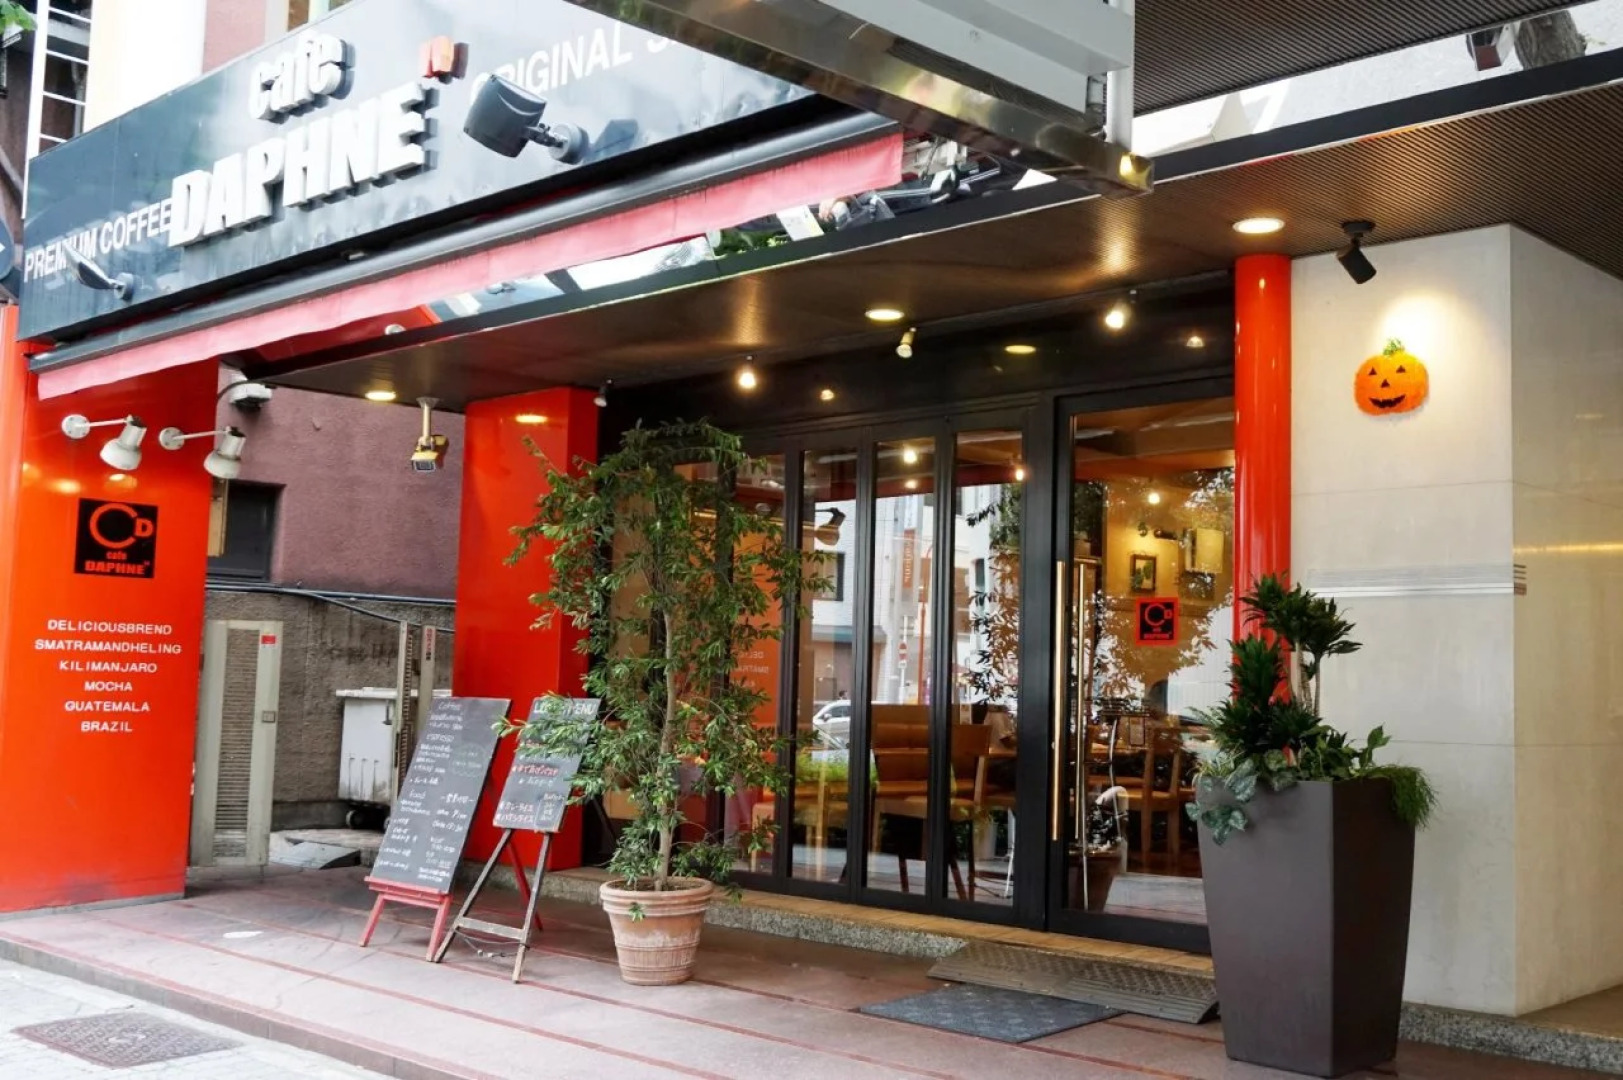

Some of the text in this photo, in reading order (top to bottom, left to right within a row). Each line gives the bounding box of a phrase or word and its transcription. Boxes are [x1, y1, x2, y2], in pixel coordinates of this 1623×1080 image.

[24, 198, 172, 283] PREMUM COFFEE
[47, 619, 172, 635] DELICIOUSBREND
[34, 639, 182, 654] SMATRAMANDHELING
[59, 660, 157, 673] KILIMANJARO
[84, 681, 133, 692] MOCHA
[64, 700, 150, 712] GUATEMALA
[80, 721, 133, 732] BRAZIL
